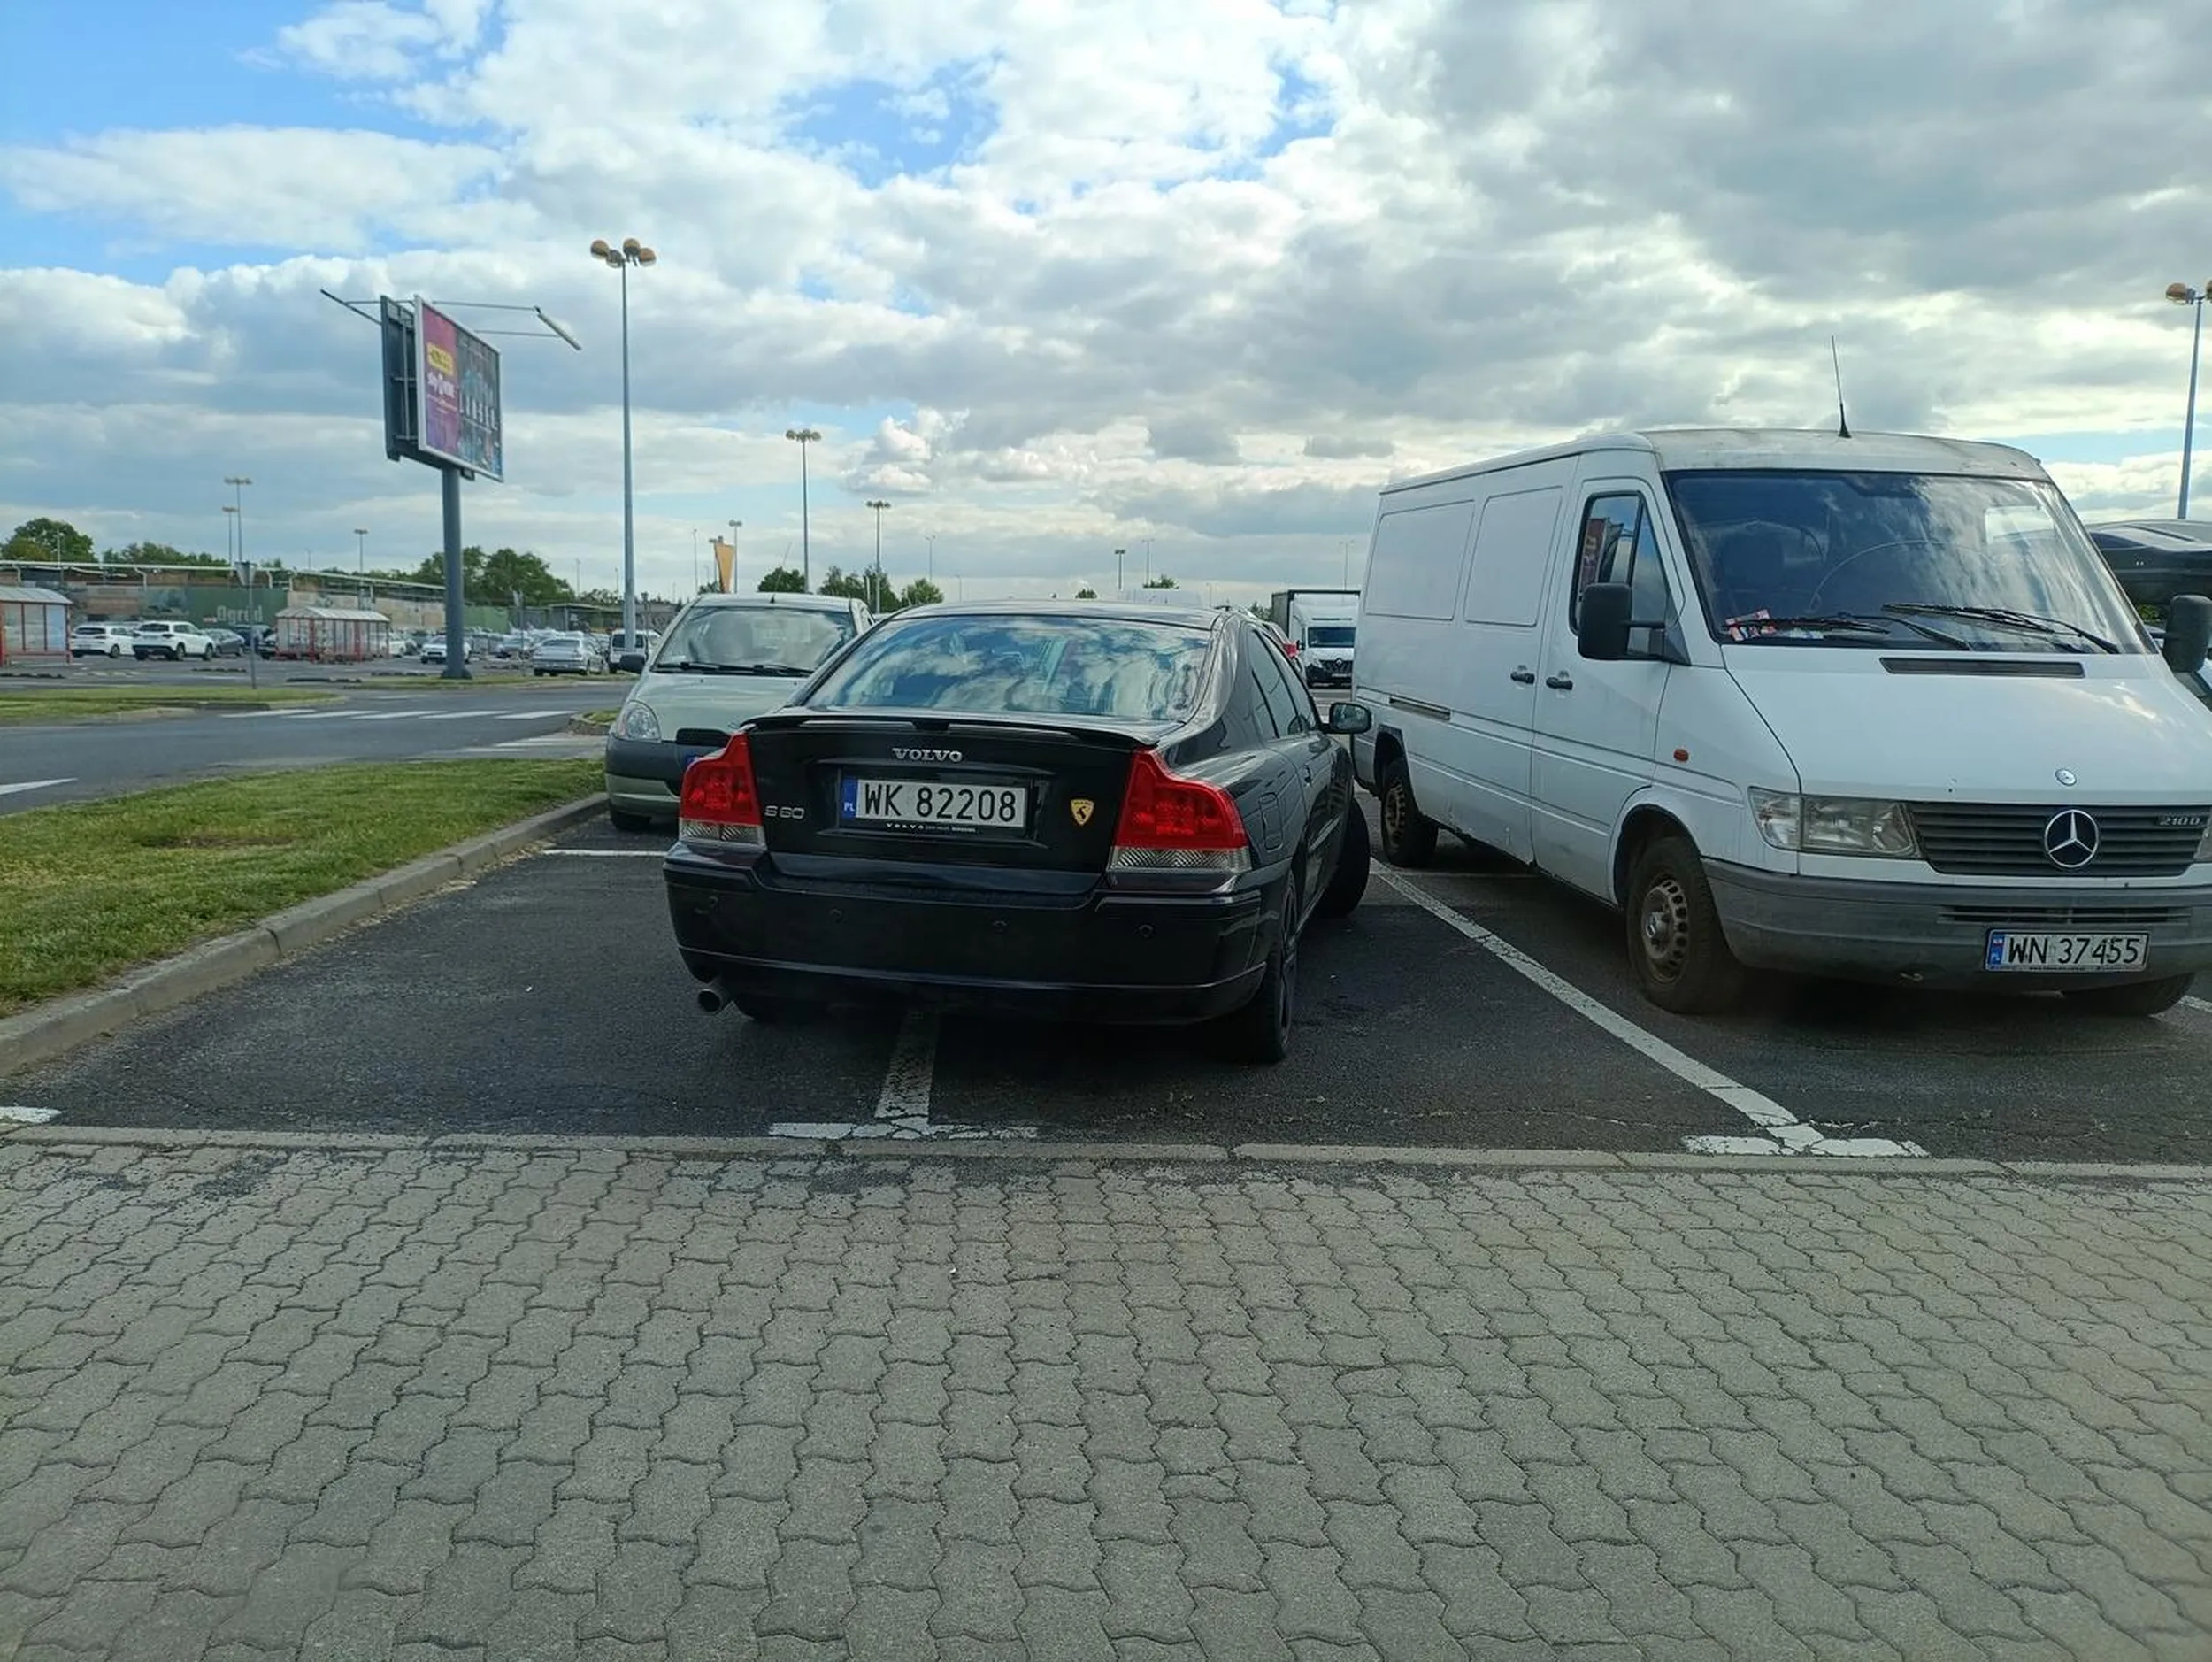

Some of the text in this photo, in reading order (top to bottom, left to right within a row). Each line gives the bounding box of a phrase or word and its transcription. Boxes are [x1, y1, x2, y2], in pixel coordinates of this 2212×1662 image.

[891, 747, 963, 762] VOLVO
[843, 801, 855, 812] PL
[864, 783, 1016, 822] WK 82208
[764, 805, 805, 819] S60
[2008, 936, 2048, 964] WN
[2057, 937, 2140, 965] 37455
